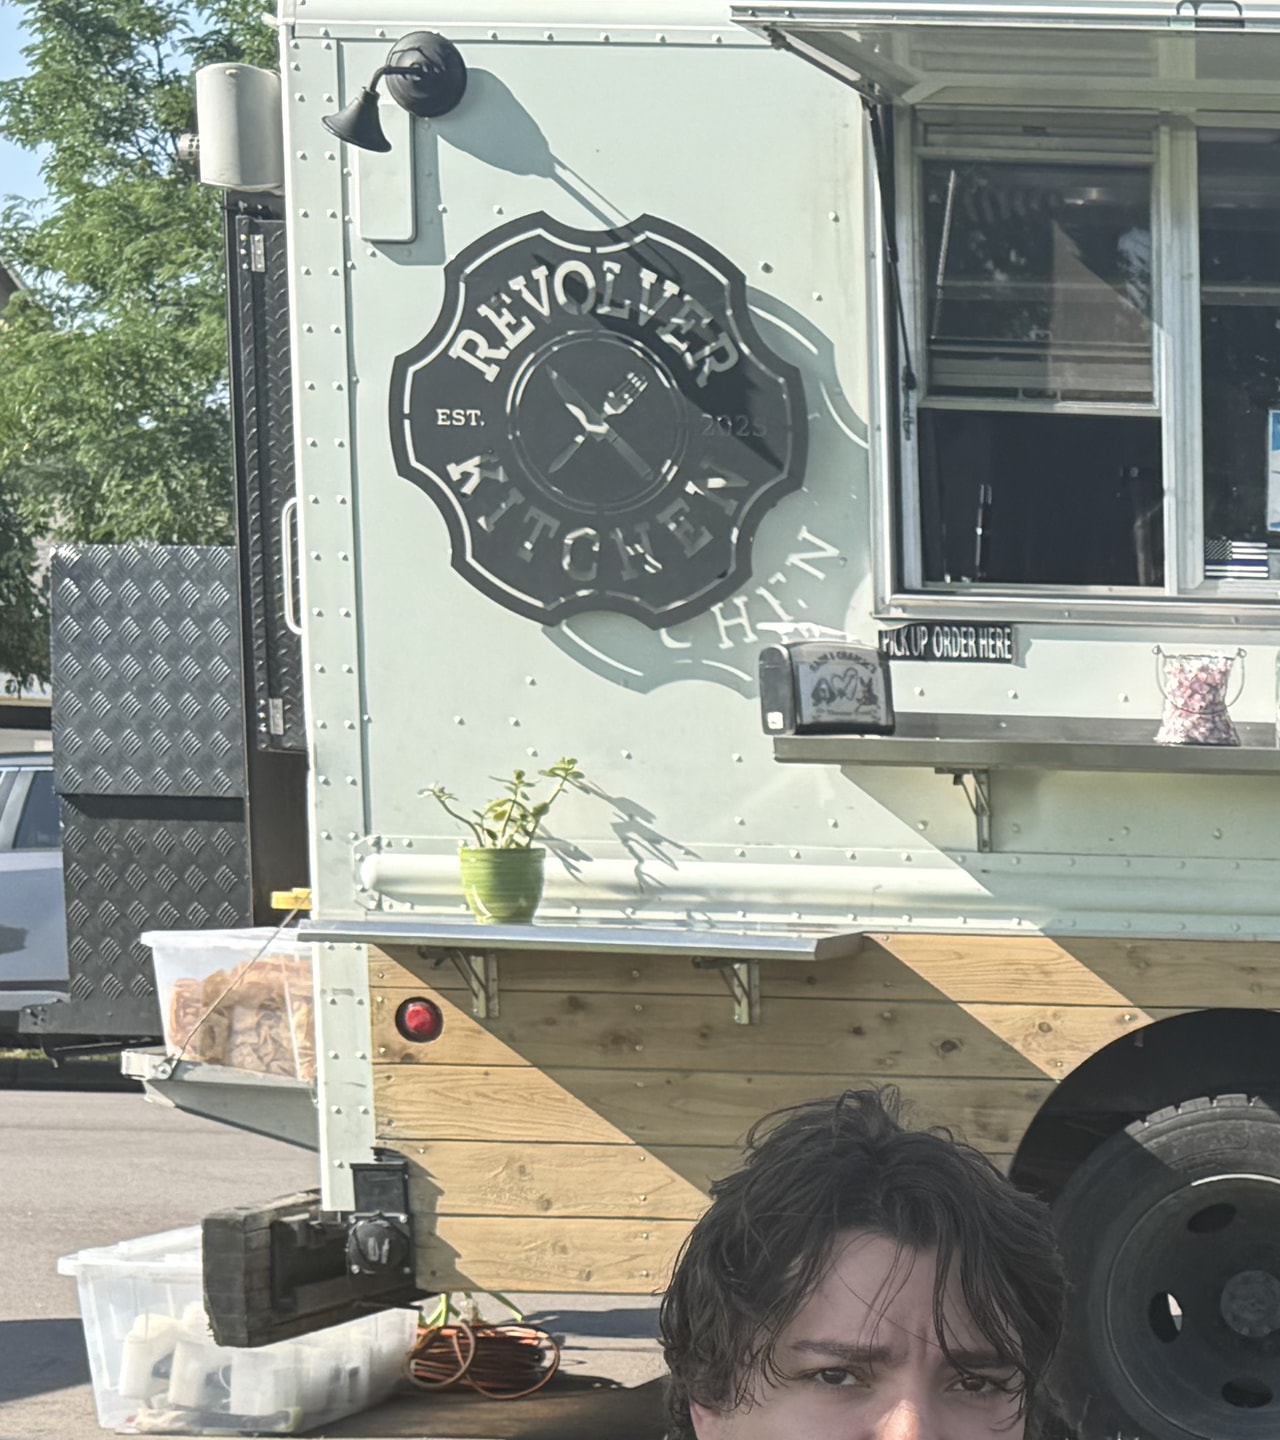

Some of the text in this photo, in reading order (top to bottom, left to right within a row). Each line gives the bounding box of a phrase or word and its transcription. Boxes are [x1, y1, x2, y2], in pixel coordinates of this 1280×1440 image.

[448, 258, 740, 389] REVOLVER
[435, 408, 486, 428] EST.
[446, 449, 750, 582] KITCHEN
[911, 625, 929, 657] UP
[932, 625, 978, 659] ORDER
[978, 626, 1013, 660] HERE
